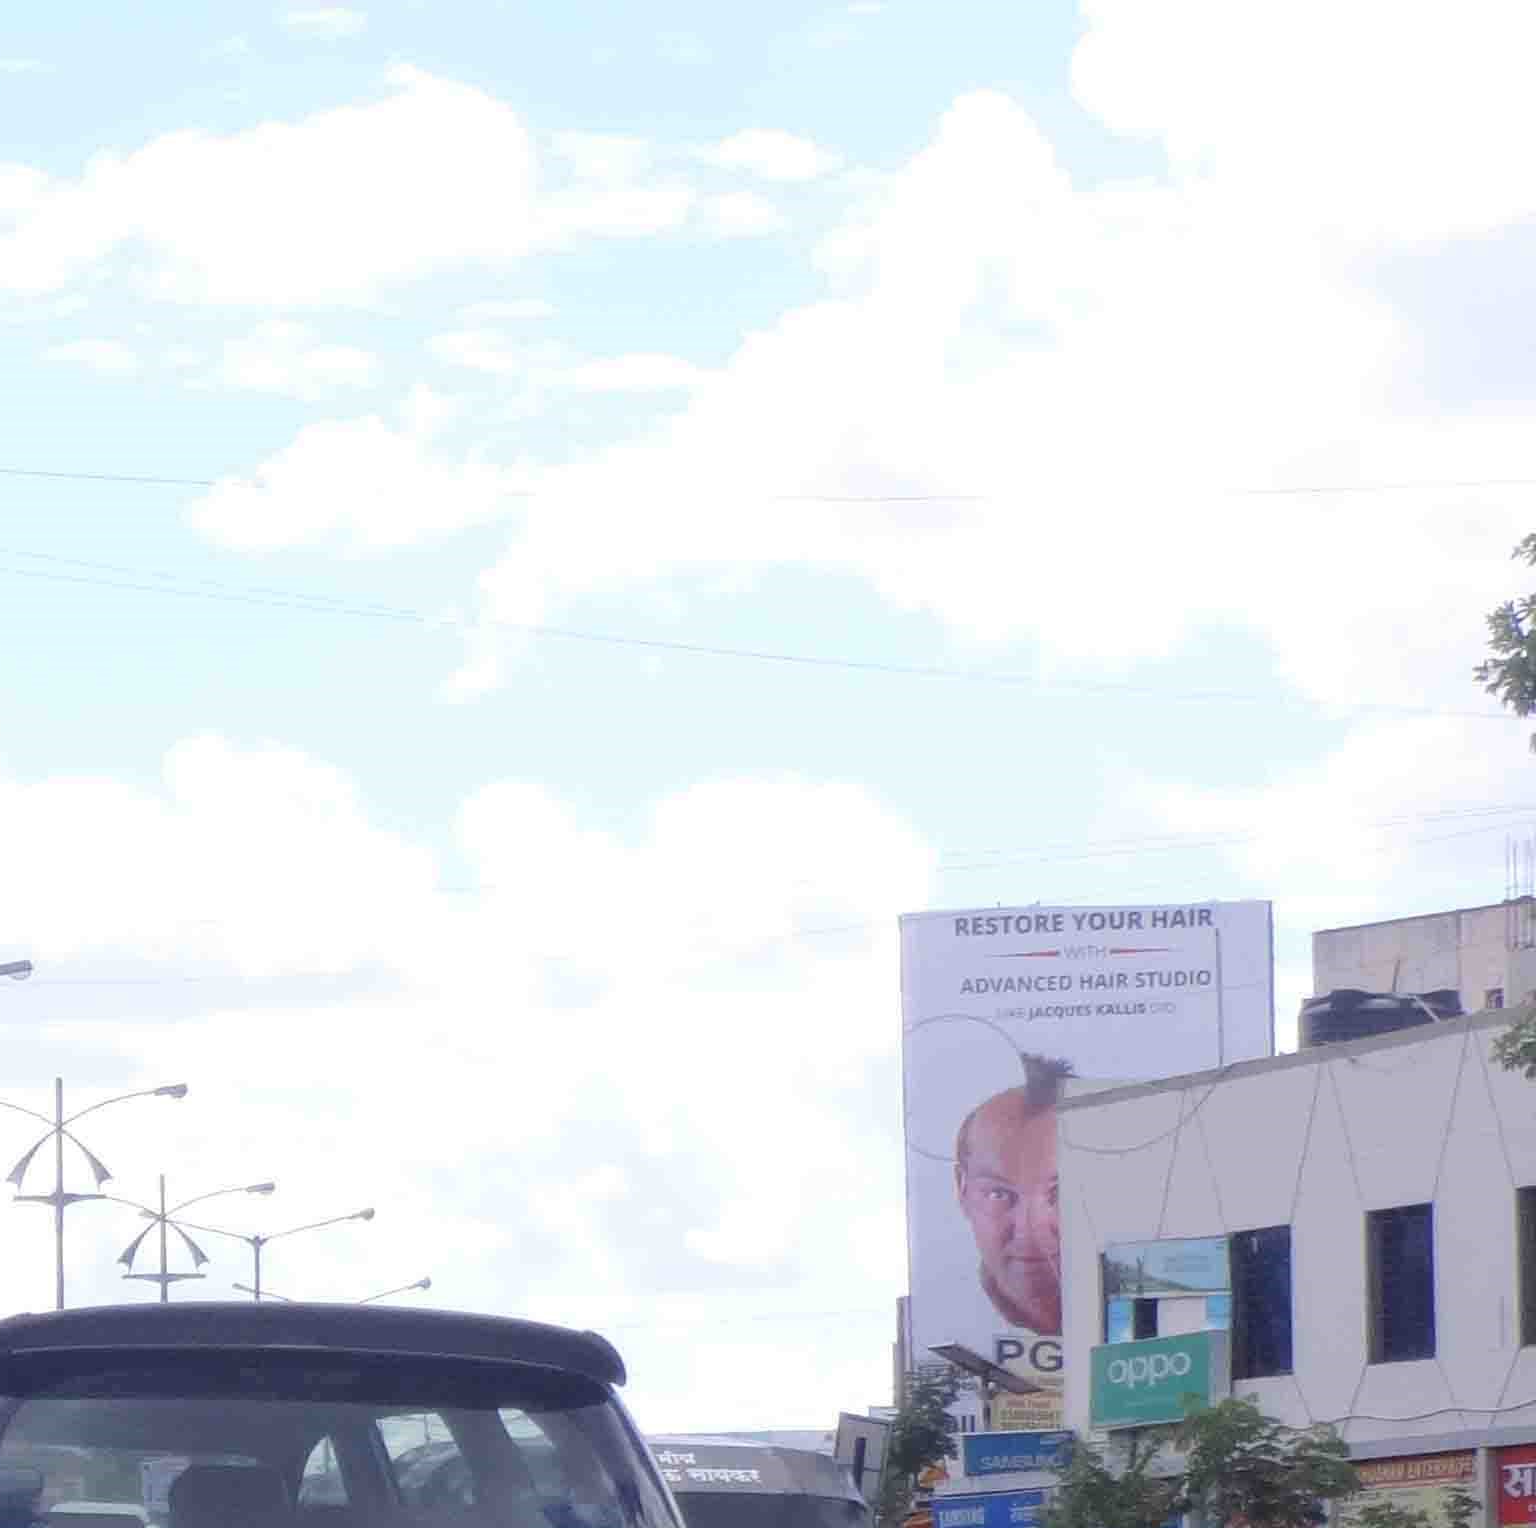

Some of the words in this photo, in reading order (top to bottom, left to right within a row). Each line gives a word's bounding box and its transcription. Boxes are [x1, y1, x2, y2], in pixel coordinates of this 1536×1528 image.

[954, 913, 1065, 937] RESTORE
[1071, 911, 1145, 932] YOUR
[1151, 908, 1214, 929] HAIR
[1063, 945, 1107, 961] WITH
[959, 975, 1073, 995] ADVANCED
[1079, 972, 1129, 992] HAIR
[1134, 970, 1212, 990] STUDIO
[1028, 1003, 1092, 1020] JACQUES
[1095, 1002, 1146, 1016] KALLIS
[1106, 1351, 1192, 1388] oppo
